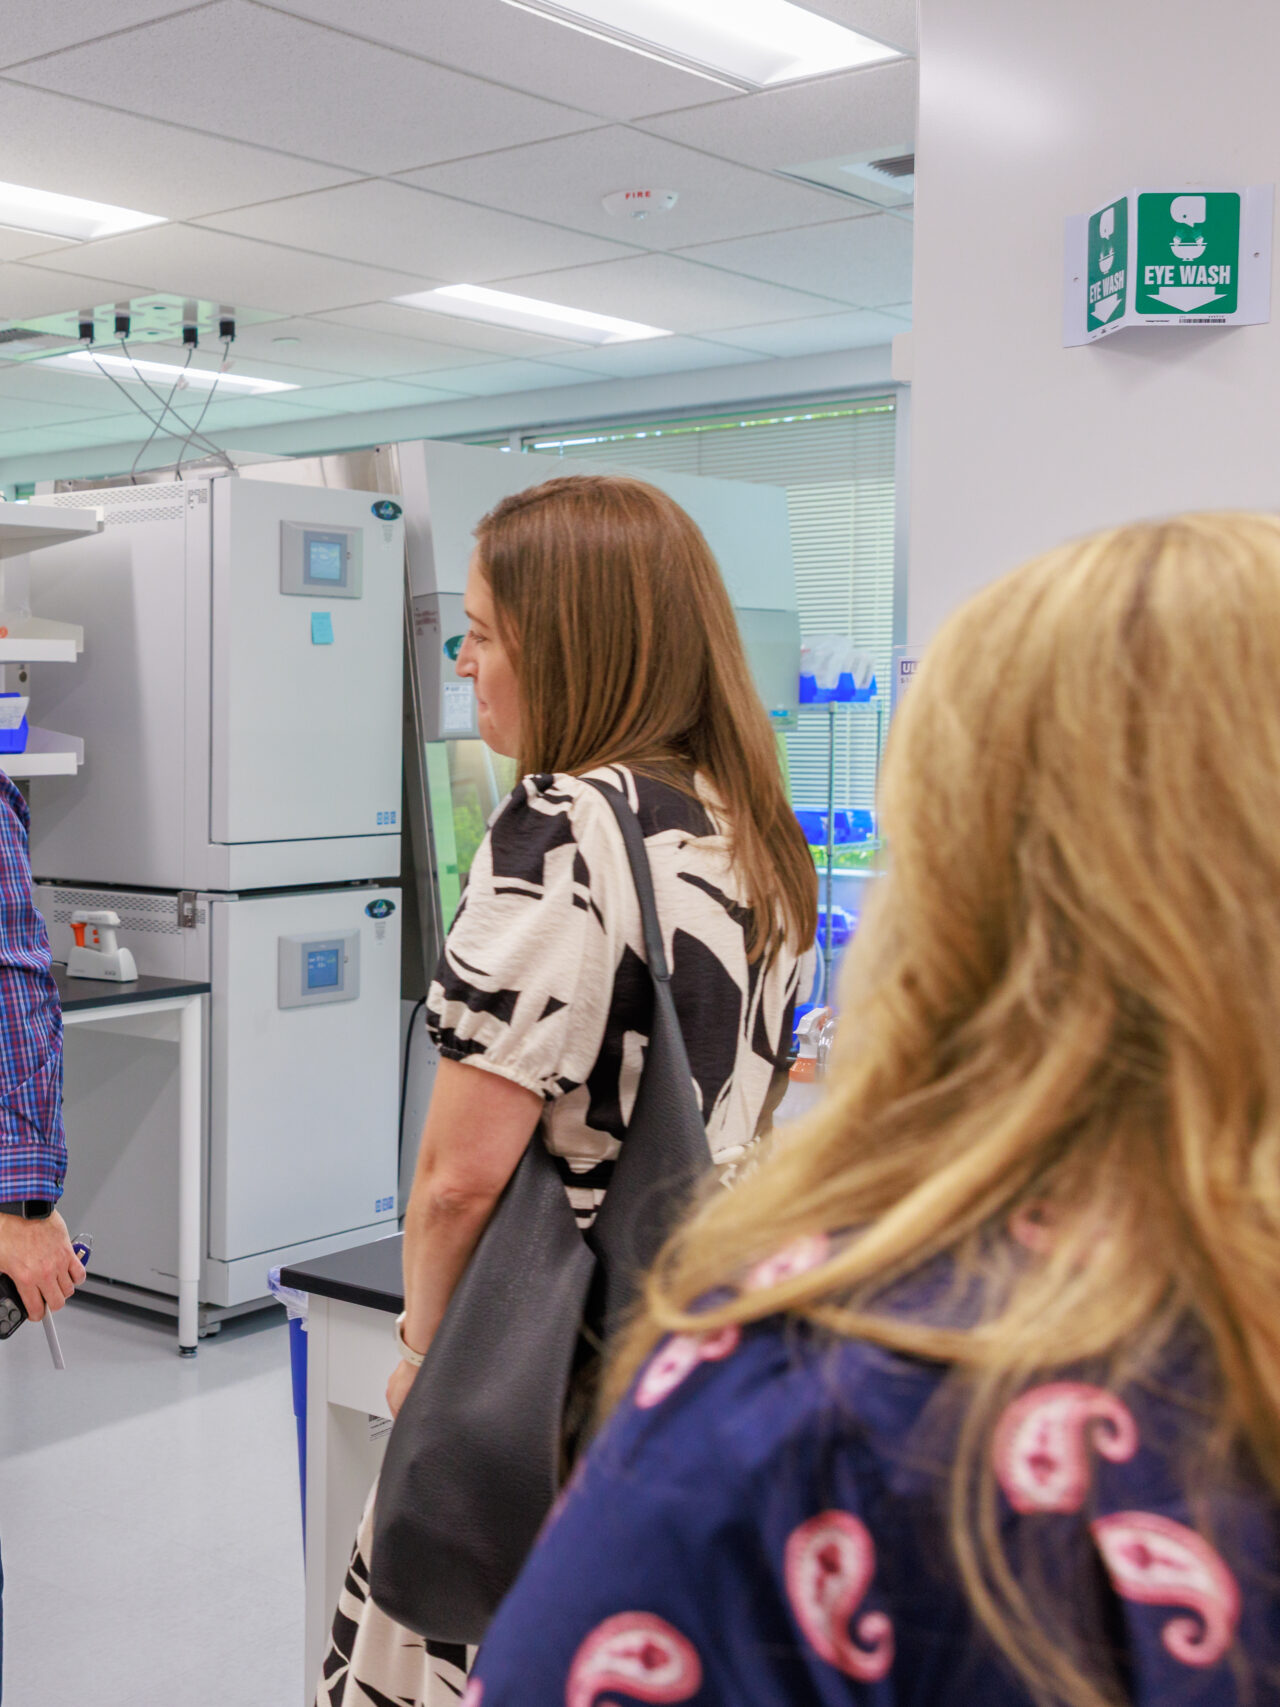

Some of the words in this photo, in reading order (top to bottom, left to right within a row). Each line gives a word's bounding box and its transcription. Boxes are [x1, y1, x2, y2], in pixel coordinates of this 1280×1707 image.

[625, 191, 651, 200] FIRE
[1144, 265, 1174, 285] EYE
[1179, 265, 1231, 285] WASH
[1089, 283, 1101, 304] EYE
[1102, 269, 1124, 297] WASH
